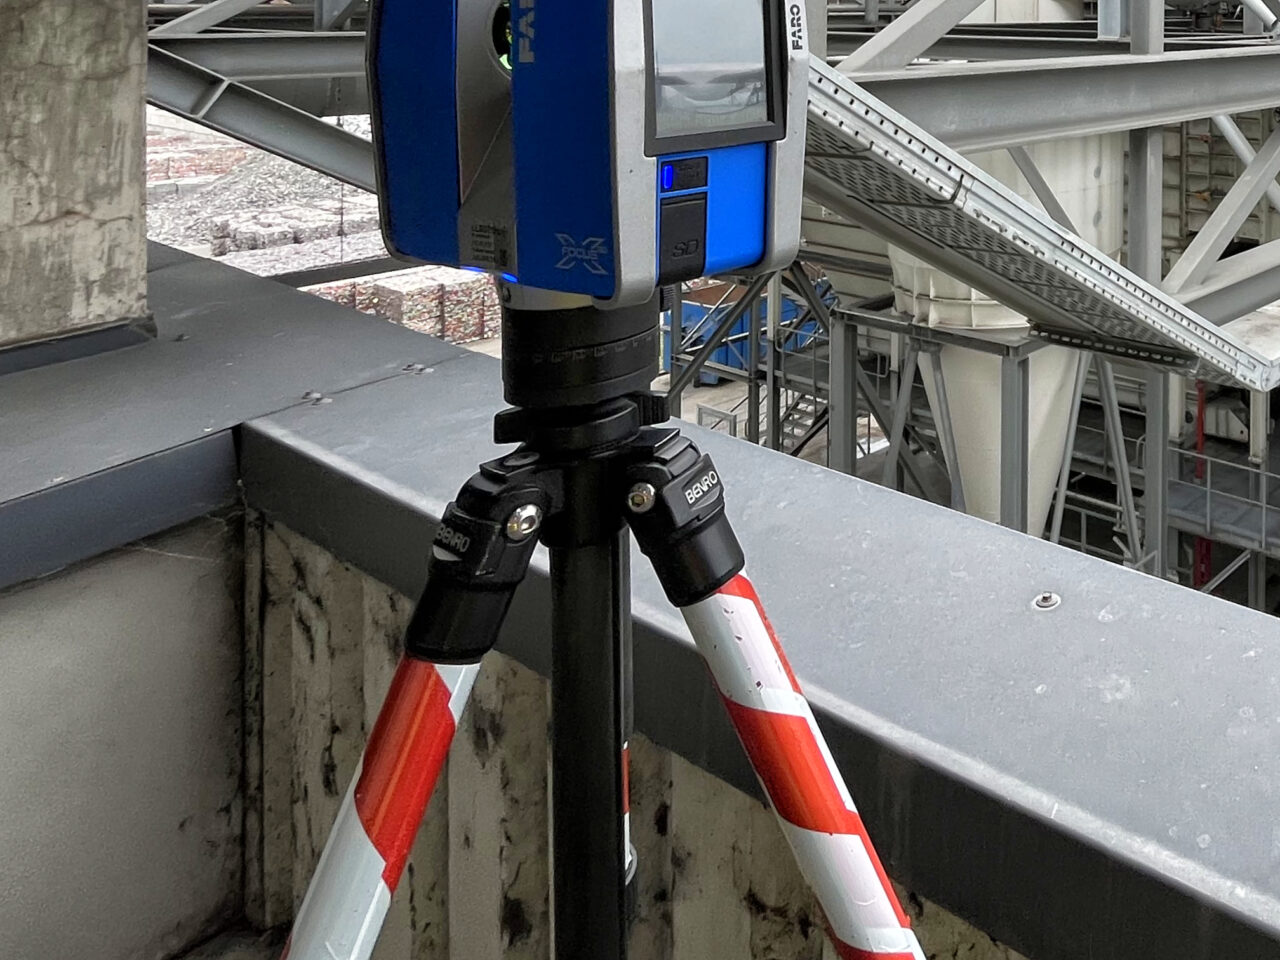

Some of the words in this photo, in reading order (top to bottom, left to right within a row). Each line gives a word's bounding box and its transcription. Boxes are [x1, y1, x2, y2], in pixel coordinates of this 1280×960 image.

[789, 4, 803, 50] FARO
[672, 239, 699, 258] SD
[685, 471, 718, 504] BENRO
[435, 522, 470, 553] BENRO
